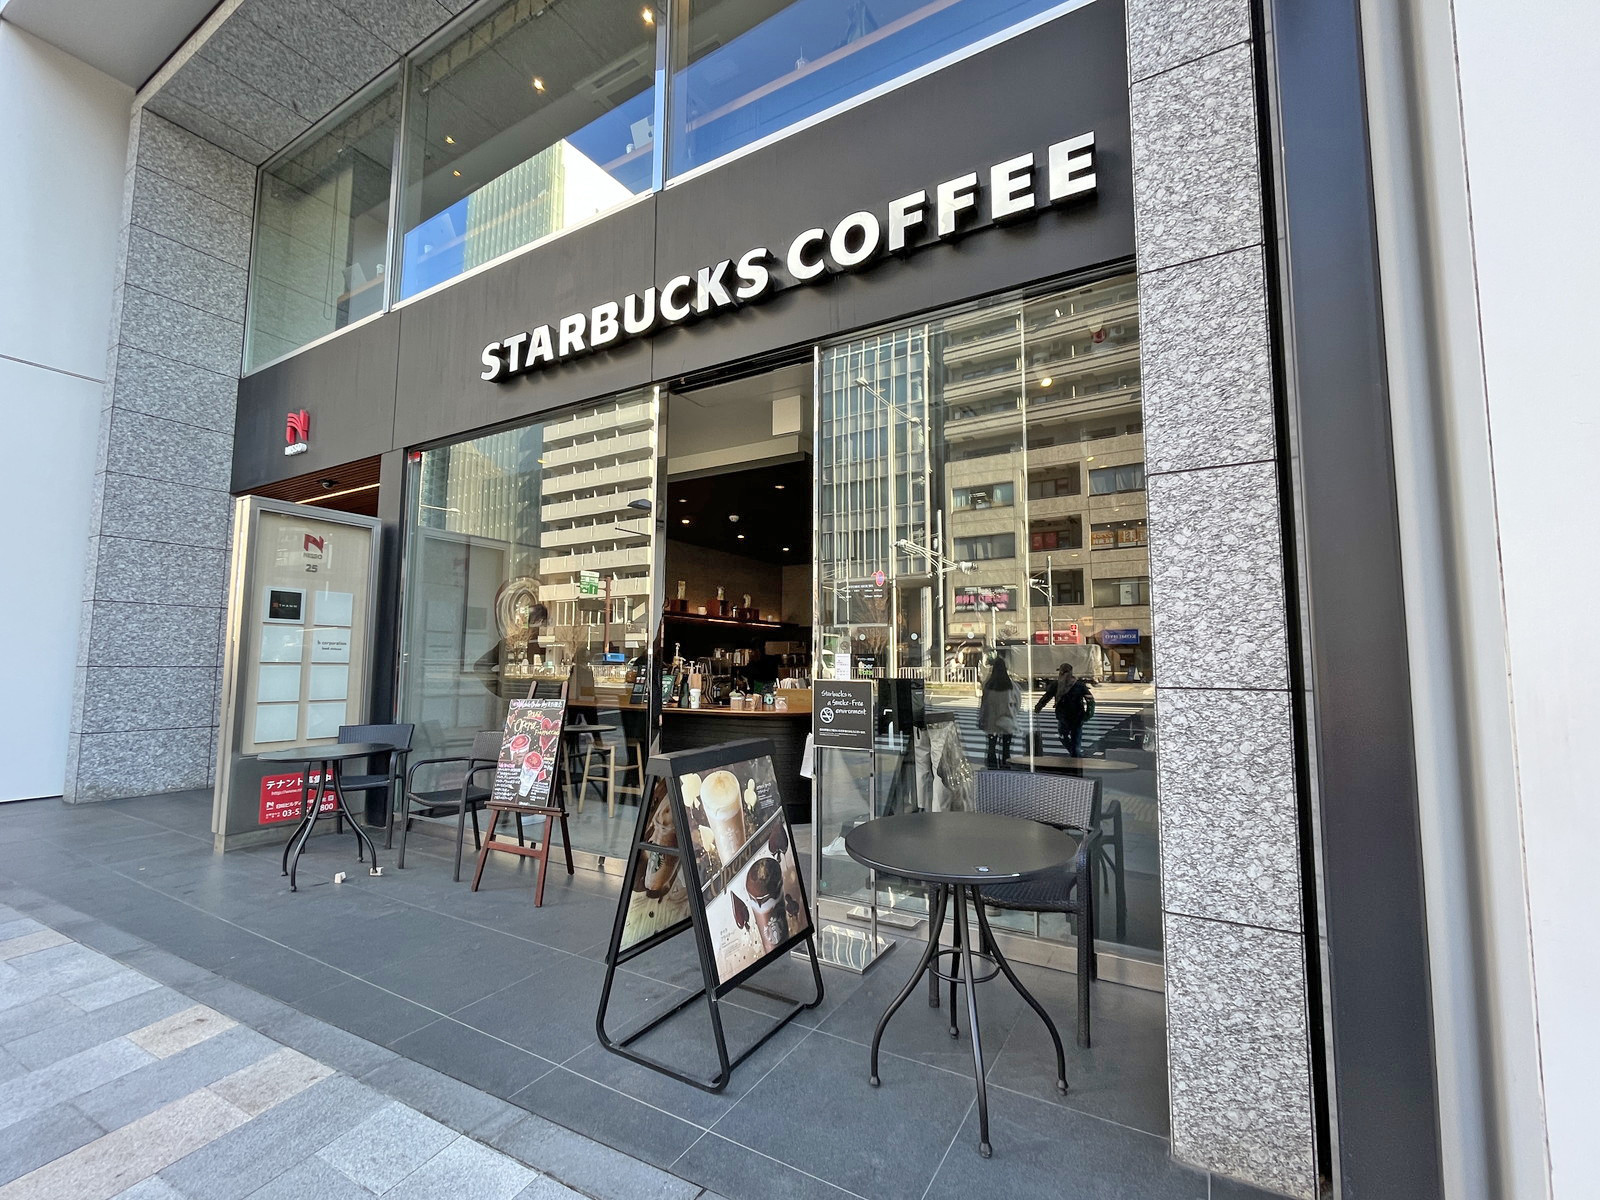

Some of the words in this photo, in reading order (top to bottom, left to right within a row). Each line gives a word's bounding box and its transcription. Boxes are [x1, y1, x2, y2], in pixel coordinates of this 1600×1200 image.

[480, 247, 773, 382] STARBUCKS
[786, 131, 1096, 281] COFFEE
[305, 563, 318, 573] 25
[820, 690, 847, 698] Starbucks
